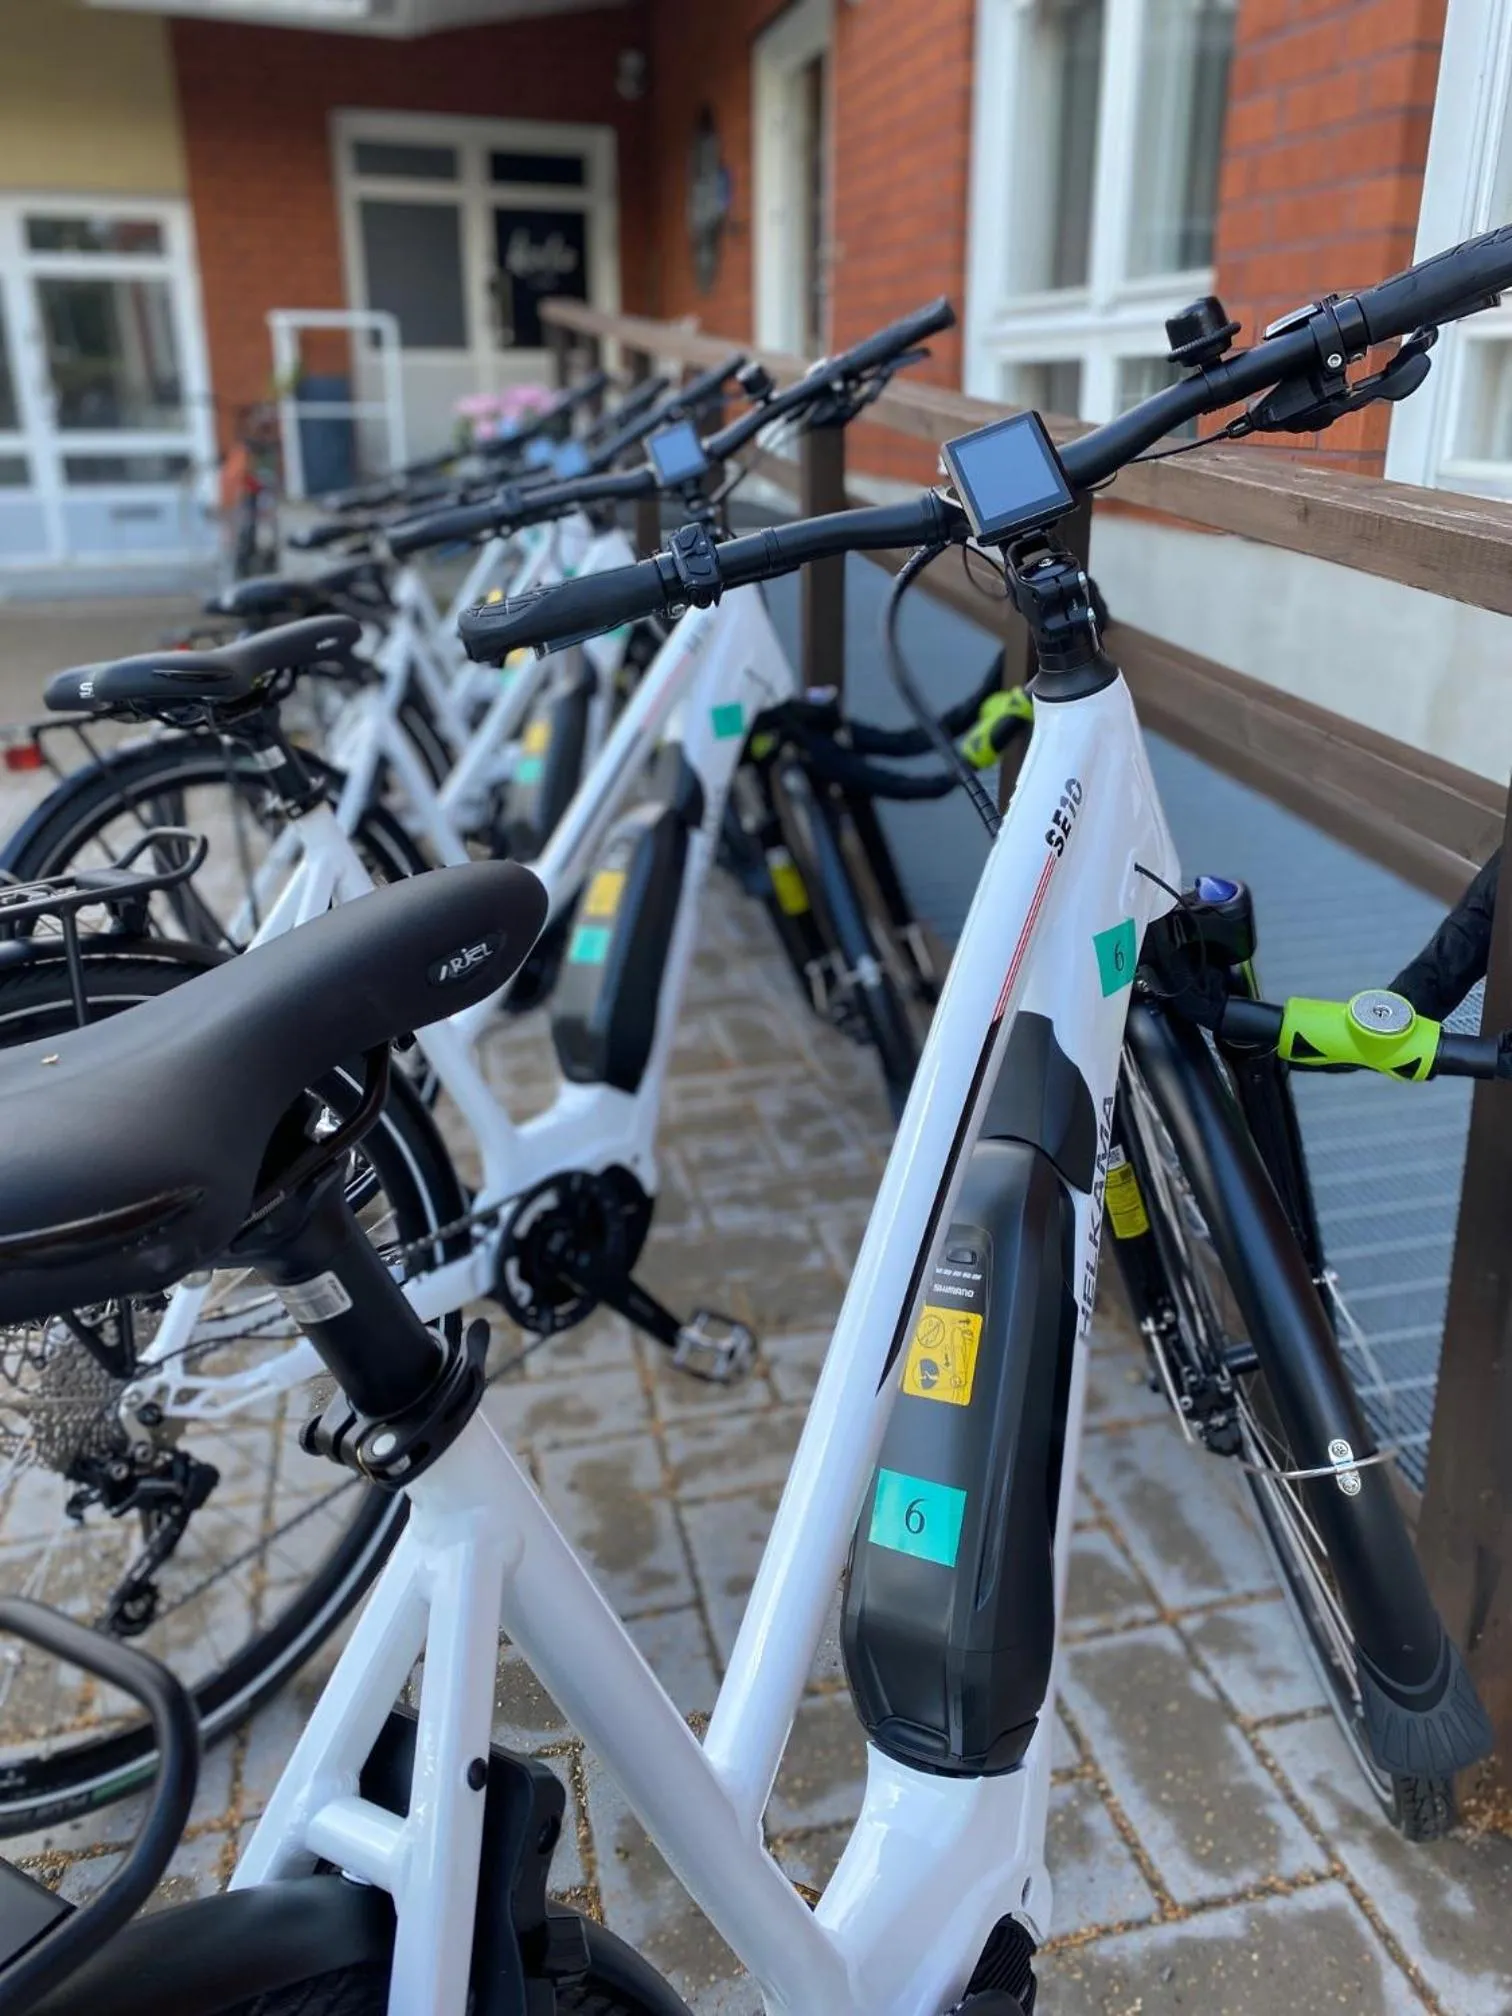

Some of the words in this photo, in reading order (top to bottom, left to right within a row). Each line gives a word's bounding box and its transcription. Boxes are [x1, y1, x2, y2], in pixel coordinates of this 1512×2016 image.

[1045, 778, 1083, 857] SE10
[1113, 942, 1125, 972] 6
[1078, 1097, 1114, 1338] HELKAMA
[905, 1497, 929, 1534] 6
